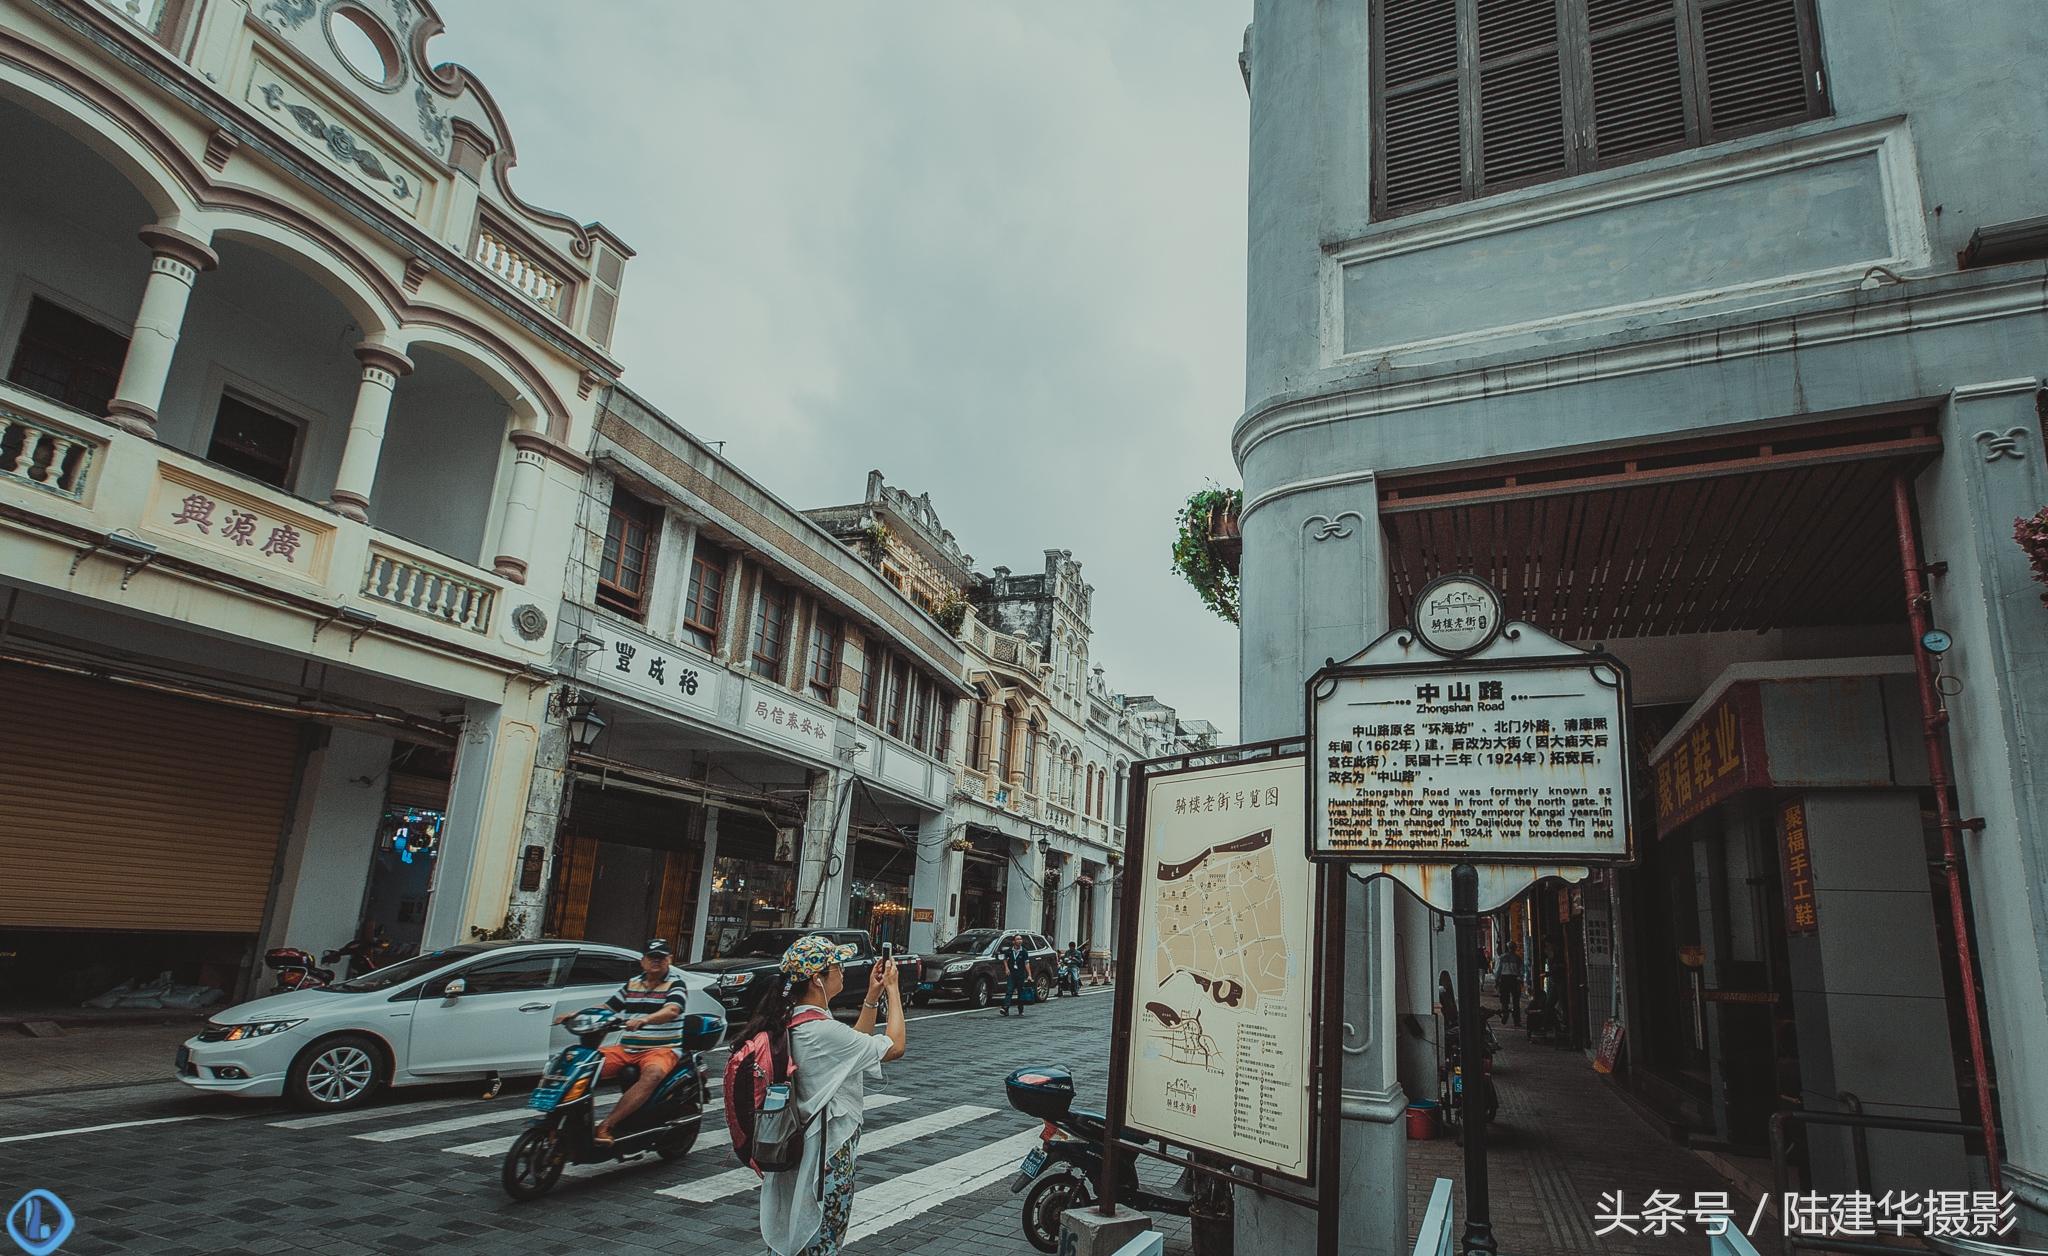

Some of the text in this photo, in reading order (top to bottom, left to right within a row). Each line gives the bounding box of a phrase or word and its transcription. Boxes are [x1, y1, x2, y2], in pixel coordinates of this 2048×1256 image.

[1416, 680, 1504, 704] 中山路
[1416, 701, 1505, 715] Zhongshan Road
[1657, 703, 1740, 818] 聚福鞋业
[1356, 788, 1413, 797] Zhongshan
[1423, 788, 1450, 796] Road
[1490, 787, 1539, 797] formerly
[1549, 786, 1588, 795] known
[1599, 787, 1611, 795] as
[1394, 798, 1424, 806] where
[1469, 797, 1493, 806] front
[1499, 797, 1510, 805] of
[1515, 797, 1531, 805] the
[1538, 797, 1566, 805] north
[1572, 798, 1598, 807] gate.
[1351, 808, 1372, 816] built
[1377, 808, 1385, 816] in
[1390, 808, 1405, 816] the
[1410, 808, 1433, 818] Qing
[1438, 808, 1476, 818] dynasty
[1481, 809, 1525, 818] emperor
[1529, 807, 1565, 818] Kangxi
[1377, 818, 1399, 826] then
[1404, 818, 1445, 828] changed
[1450, 818, 1469, 826] into
[1545, 818, 1563, 826] the
[1568, 818, 1585, 826] Tin
[1592, 818, 1613, 827] Hau
[1328, 828, 1362, 838] Temple
[1369, 828, 1378, 836] in
[1385, 828, 1403, 836] this
[1529, 828, 1585, 837] broadened
[1593, 828, 1614, 837] and
[1328, 838, 1369, 847] renamed
[1384, 838, 1438, 848] Zhongshan
[1441, 838, 1470, 847] Road.
[1784, 805, 1815, 926] 聚福手工鞋
